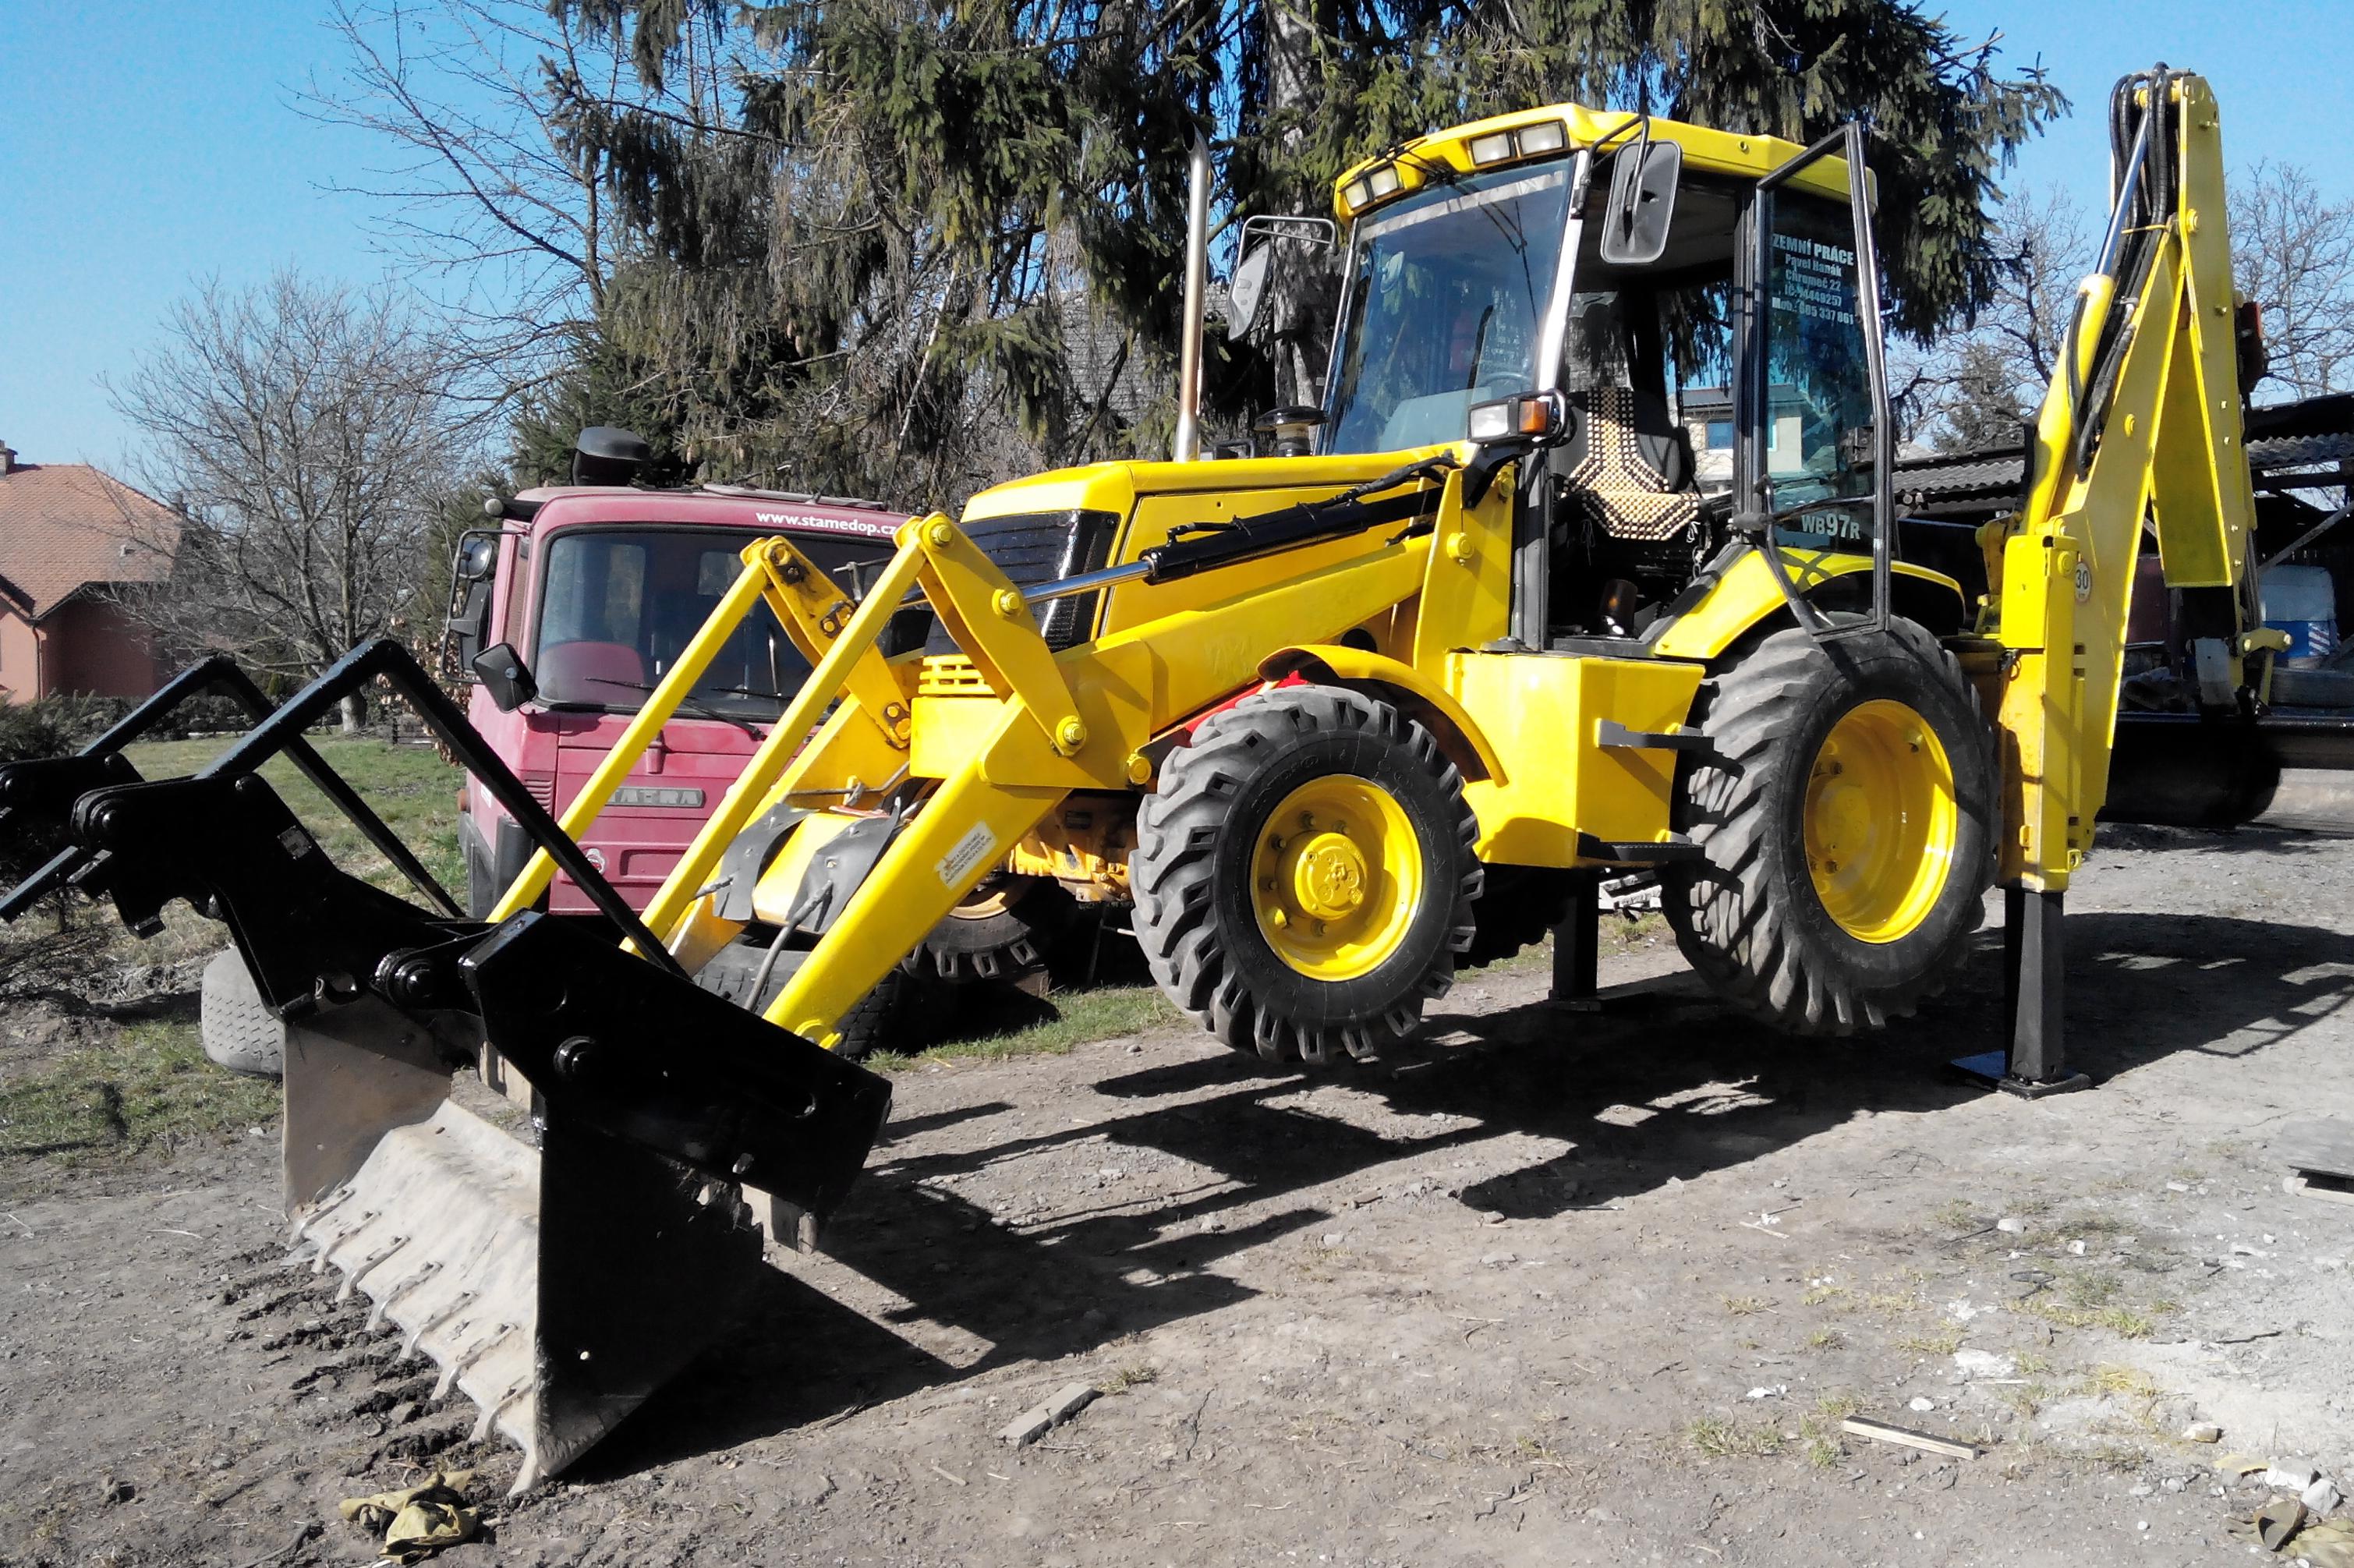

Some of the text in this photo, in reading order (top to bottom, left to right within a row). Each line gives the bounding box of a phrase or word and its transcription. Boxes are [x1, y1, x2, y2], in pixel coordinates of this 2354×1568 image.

[1772, 234, 1853, 266] ZEMNÍ PRÁCE
[1785, 253, 1811, 269] Pavel
[1785, 268, 1841, 292] Chromeč 22
[1819, 306, 1836, 321] 337
[1837, 311, 1854, 325] 861
[756, 512, 897, 536] www.stamedop.cz
[1801, 514, 1860, 540] WB97R
[2076, 569, 2089, 589] 30
